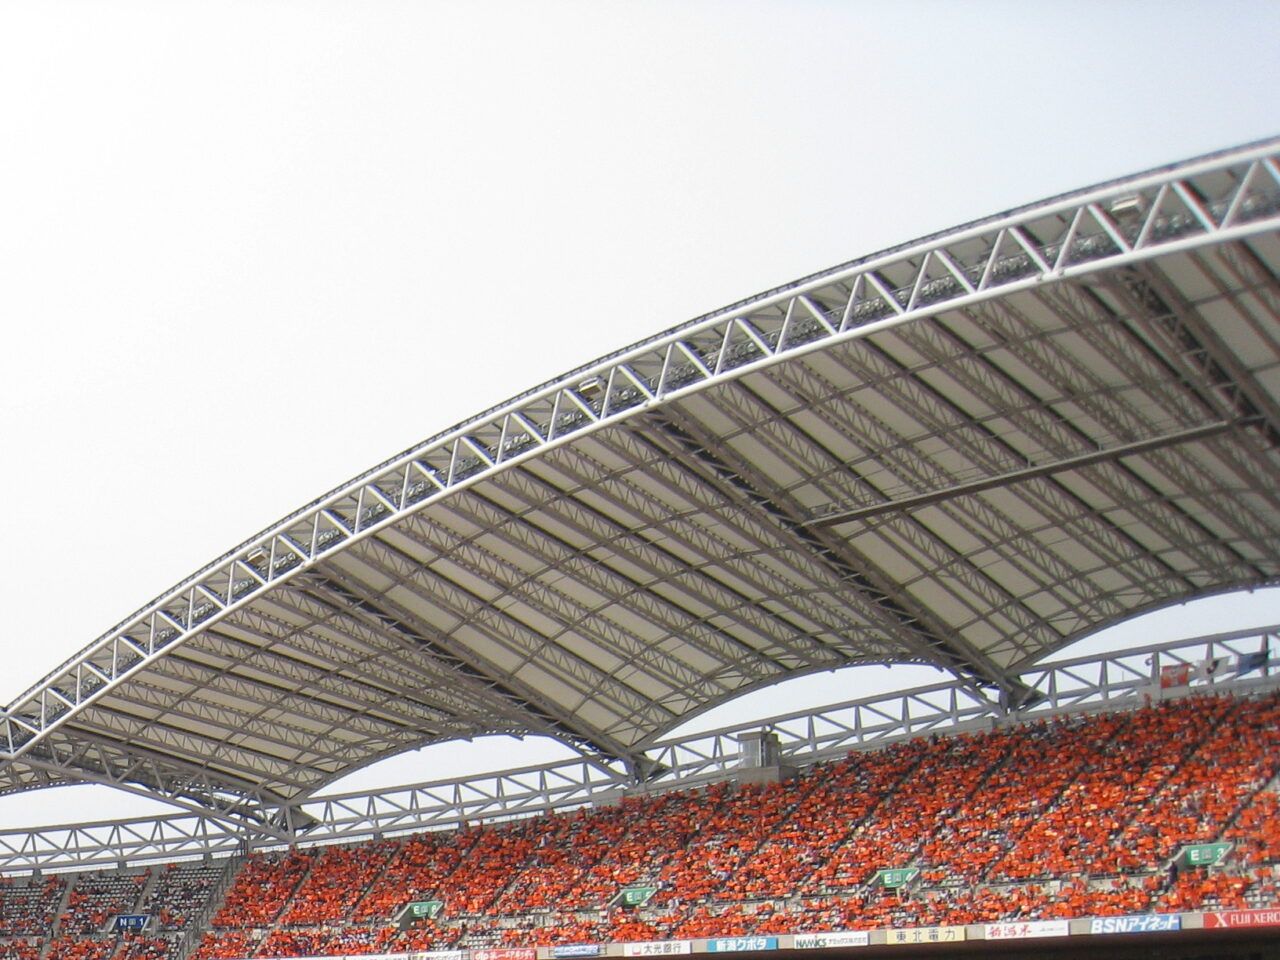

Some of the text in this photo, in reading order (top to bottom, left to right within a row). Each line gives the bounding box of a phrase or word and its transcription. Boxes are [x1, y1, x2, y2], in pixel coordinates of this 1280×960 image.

[1230, 913, 1250, 925] FUJI
[896, 929, 956, 943] 東北電力
[716, 938, 768, 952] 新潟クボタ
